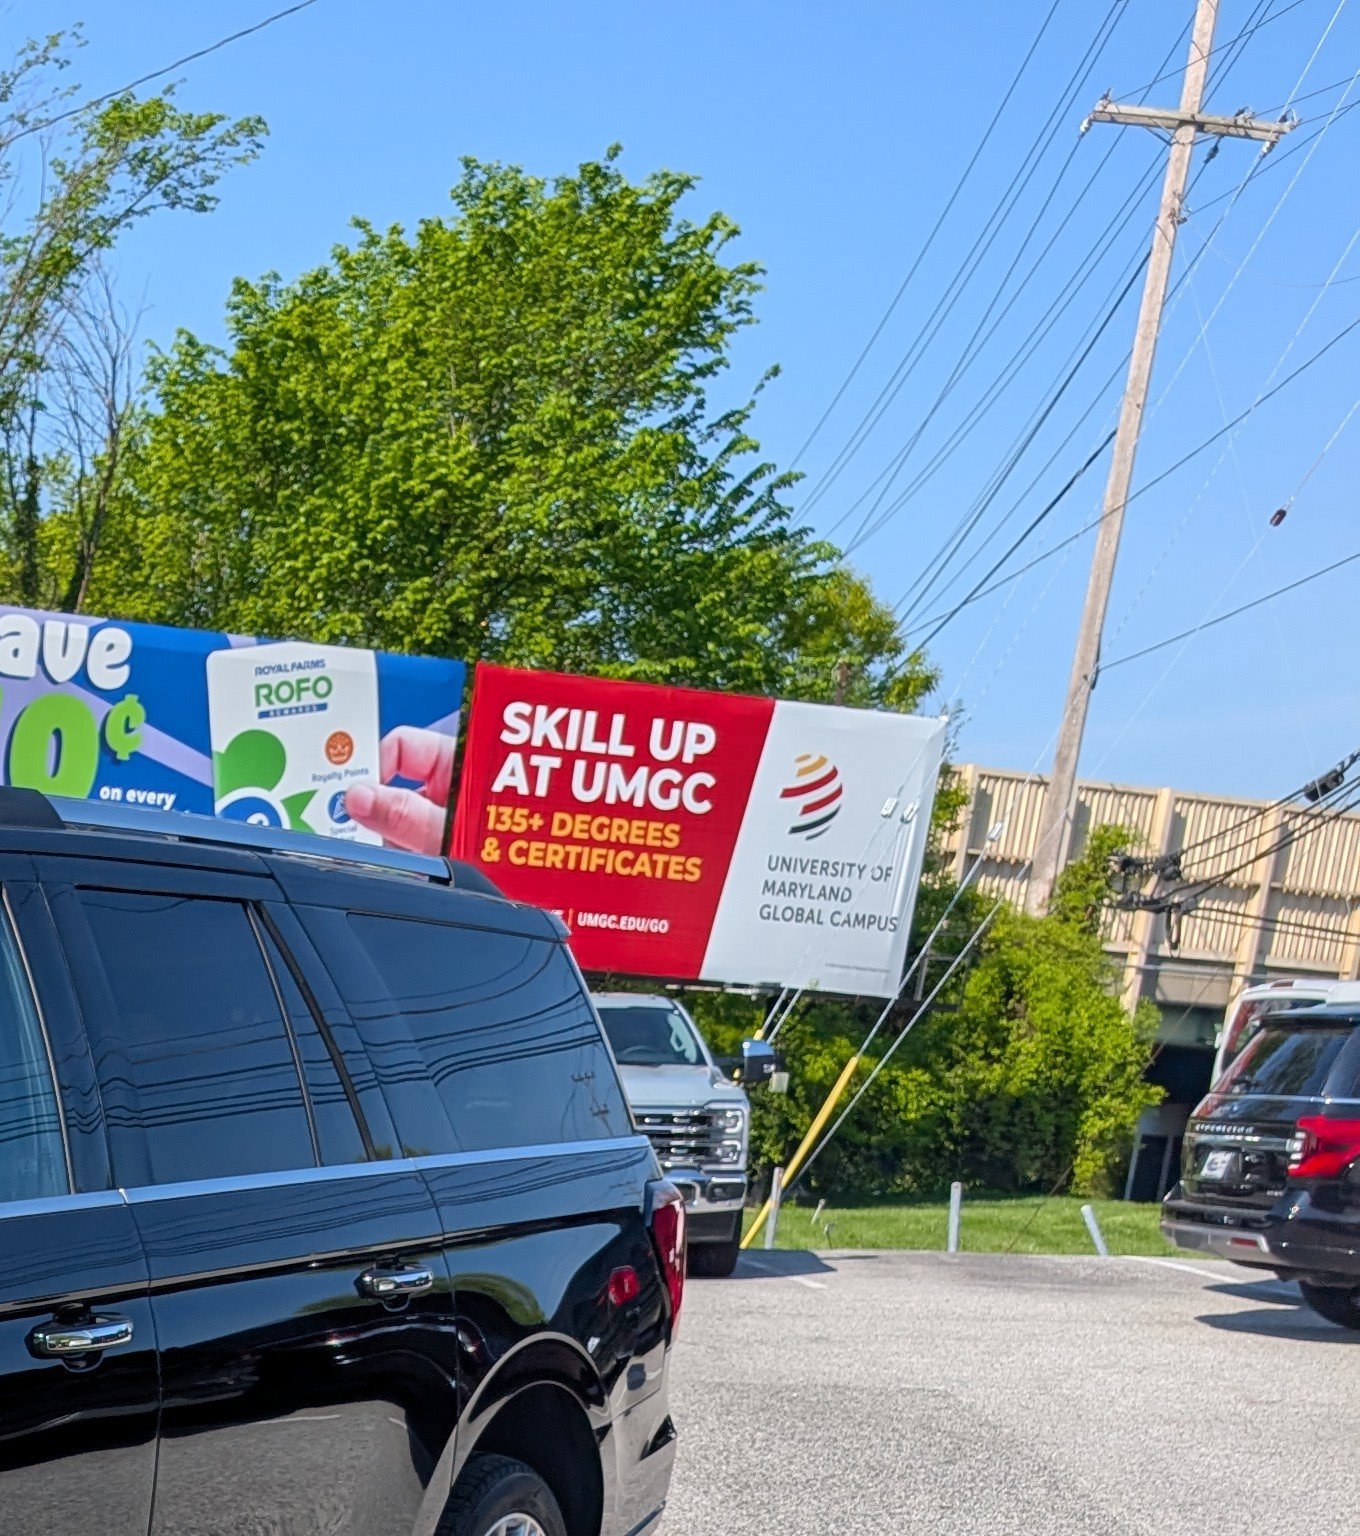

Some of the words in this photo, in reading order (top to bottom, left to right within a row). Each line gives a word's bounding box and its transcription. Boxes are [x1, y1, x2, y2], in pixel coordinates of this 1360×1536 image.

[255, 664, 290, 676] ROYAL
[291, 658, 327, 673] FARMS
[255, 675, 333, 708] ROFO
[500, 701, 636, 757] SKILL
[649, 718, 717, 764] UP
[99, 785, 122, 802] on
[125, 786, 177, 811] every
[491, 752, 562, 798] AT
[571, 759, 717, 815] UMGC
[486, 804, 544, 832] 135+
[551, 811, 681, 849] DEGREES
[480, 837, 501, 863] &
[508, 839, 703, 883] CERTIFICATES
[767, 854, 868, 881] UNIVERSITY
[870, 864, 894, 883] OF
[761, 879, 853, 904] MARYLAND
[577, 911, 670, 935] UMGC.EDU/GO
[759, 903, 825, 926] GLOBAL
[830, 910, 899, 933] CAMPUS
